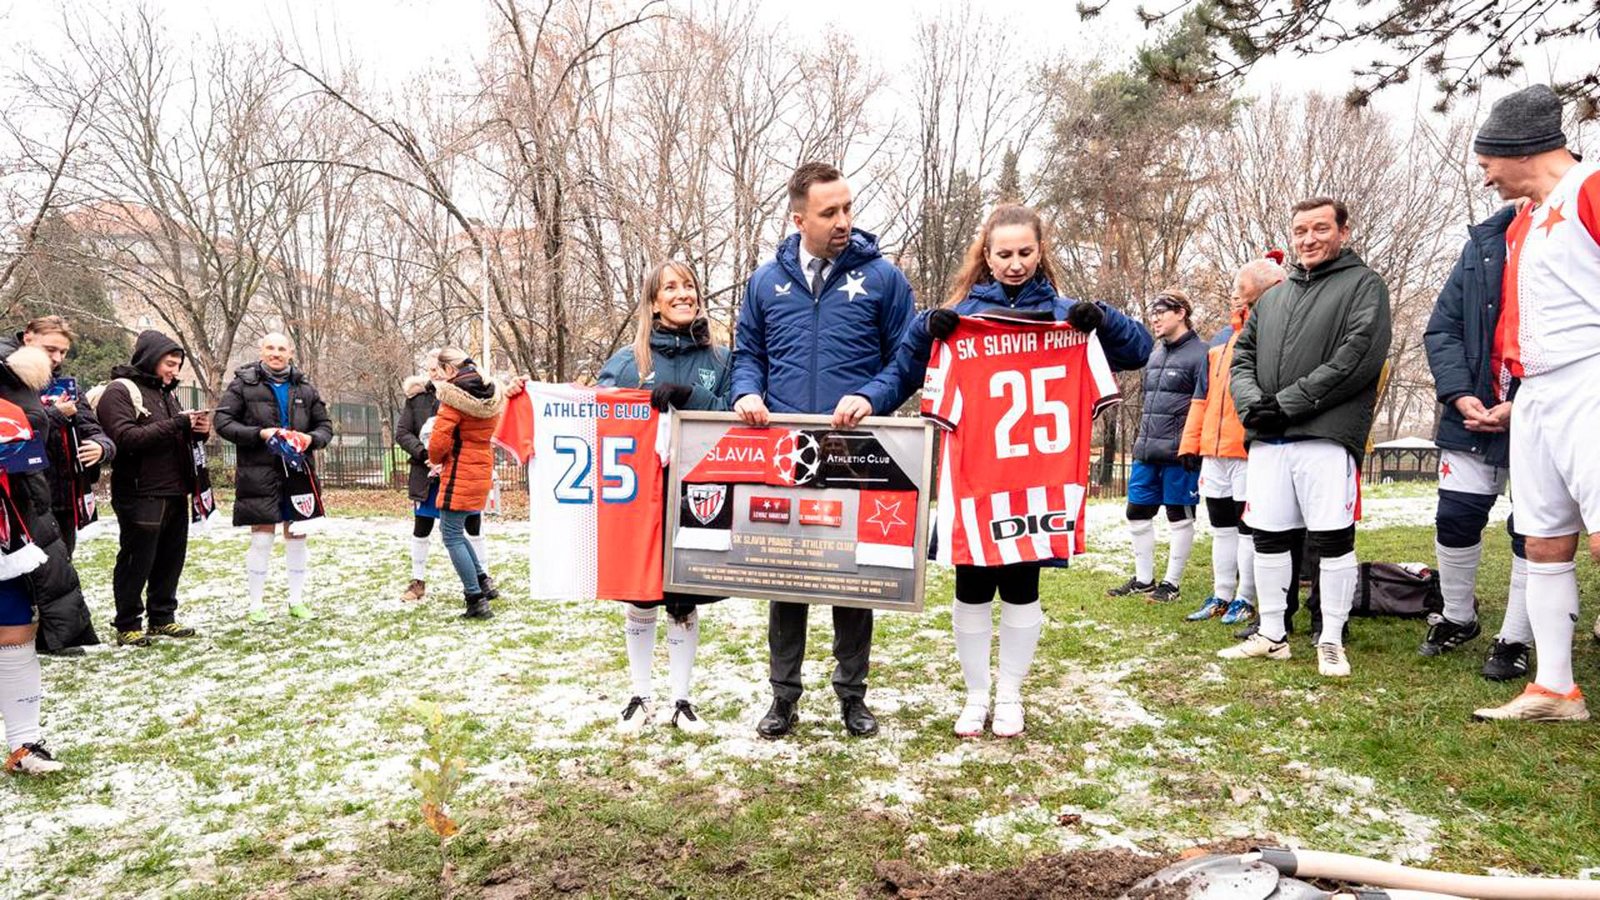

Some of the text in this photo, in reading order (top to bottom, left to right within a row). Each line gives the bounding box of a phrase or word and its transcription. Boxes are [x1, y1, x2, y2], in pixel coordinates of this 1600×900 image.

[956, 337, 979, 361] SK
[983, 332, 1038, 357] SLAVIA
[543, 402, 651, 420] ATHLETIC CLUB
[989, 365, 1071, 460] 25
[706, 446, 766, 463] SLAVIA
[553, 435, 638, 504] 25
[744, 535, 766, 547] SLAVIA
[801, 539, 835, 551] ATHLETIC
